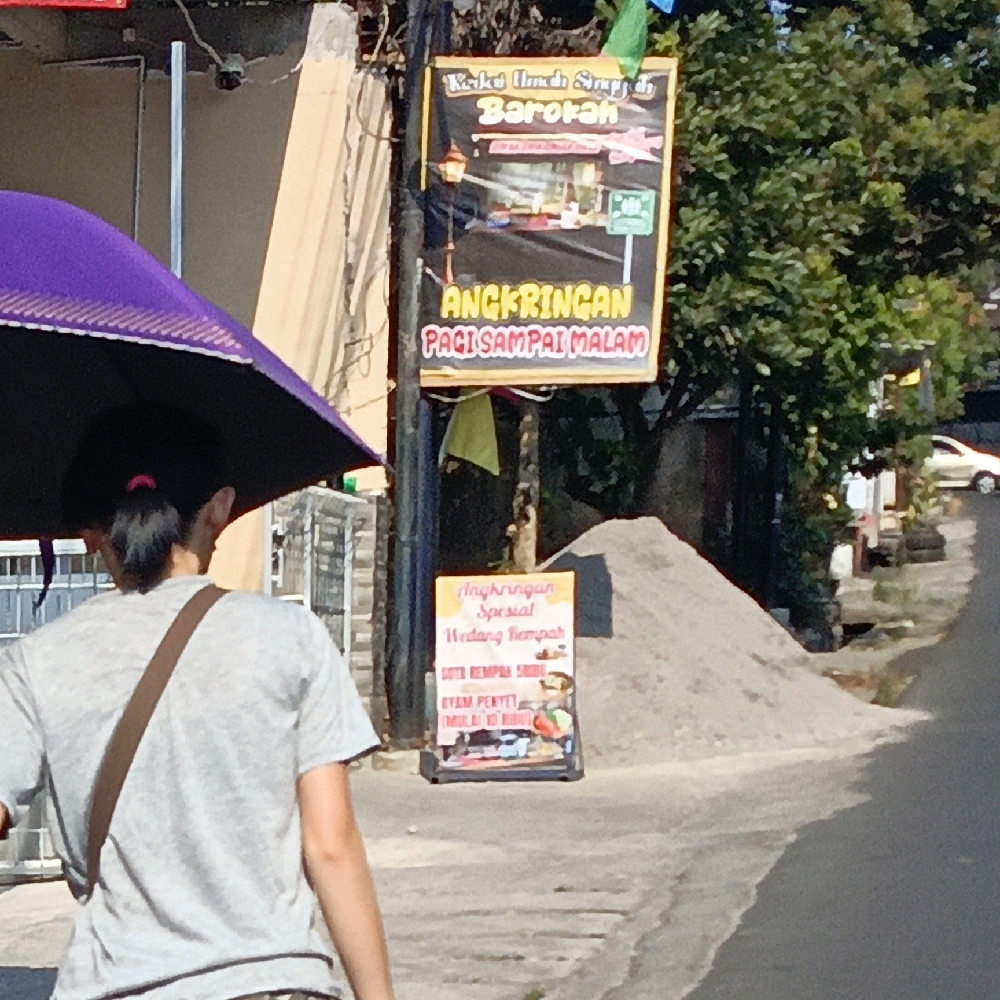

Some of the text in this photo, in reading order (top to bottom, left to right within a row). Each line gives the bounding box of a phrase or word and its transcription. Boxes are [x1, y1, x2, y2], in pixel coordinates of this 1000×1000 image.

[477, 97, 618, 125] Barokah
[440, 283, 633, 321] ANGKRINGAN
[423, 326, 648, 357] PAGI SAMPAI MALAM
[457, 581, 555, 600] Angkringan
